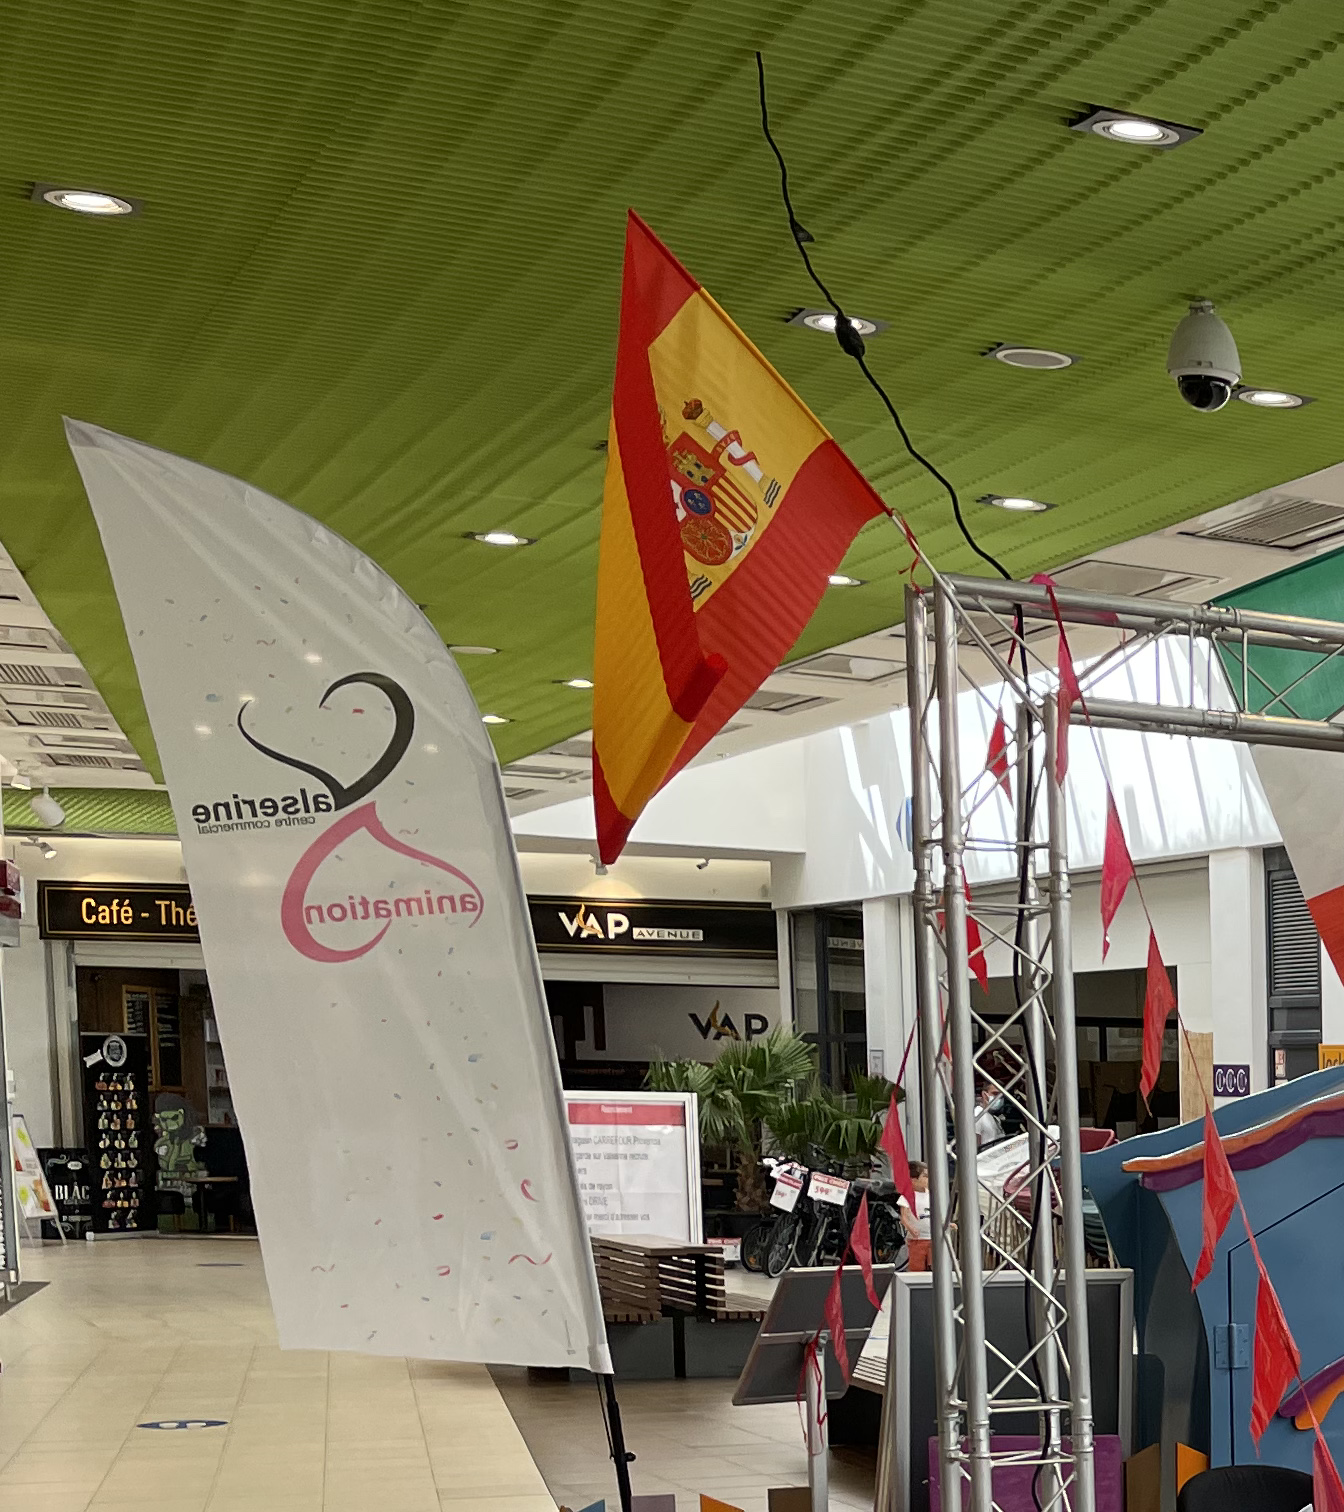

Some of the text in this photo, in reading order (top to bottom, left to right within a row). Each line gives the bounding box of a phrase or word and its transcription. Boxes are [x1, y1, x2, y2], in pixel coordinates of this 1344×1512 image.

[81, 897, 134, 925] Café
[558, 908, 701, 939] VAP AVENUE
[688, 1012, 769, 1041] VAP
